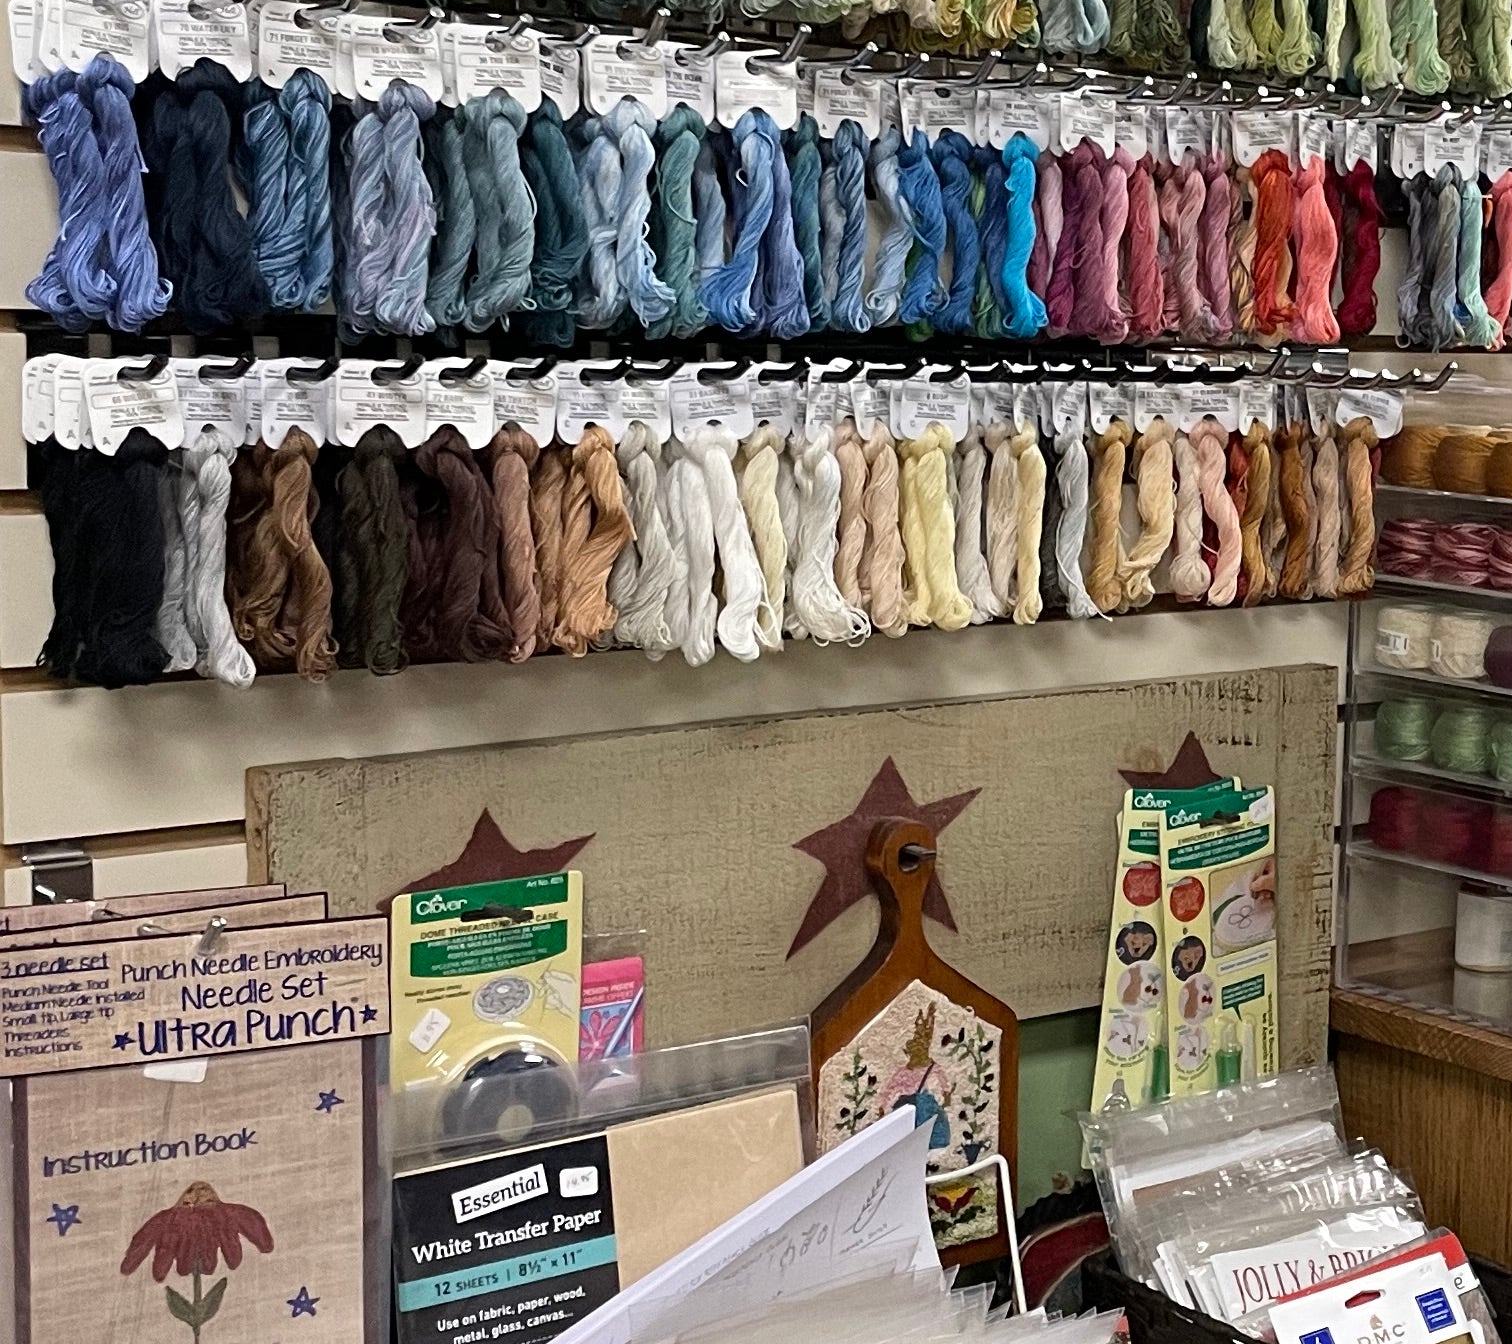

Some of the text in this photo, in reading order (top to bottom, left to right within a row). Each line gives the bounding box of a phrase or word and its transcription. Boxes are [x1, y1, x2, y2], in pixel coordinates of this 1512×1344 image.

[1134, 793, 1171, 809] Clover
[1169, 809, 1202, 827] Clover
[415, 896, 467, 916] Clover
[536, 911, 559, 921] CASE
[420, 929, 447, 940] DOME
[449, 921, 496, 935] THREADED
[80, 952, 109, 970] set
[121, 960, 187, 984] Punch
[191, 954, 259, 977] Needle
[182, 971, 328, 1011] Needle Set
[246, 1001, 355, 1044] Punch
[194, 1127, 258, 1157] Book
[458, 1171, 542, 1217] Essential
[411, 1208, 602, 1264] White Transfer Paper
[434, 1281, 451, 1297] 12
[456, 1273, 499, 1292] SHEETS
[1232, 1259, 1326, 1314] JOLLY &
[437, 1315, 459, 1332] Use
[462, 1314, 477, 1327] on
[517, 1296, 551, 1316] paper,
